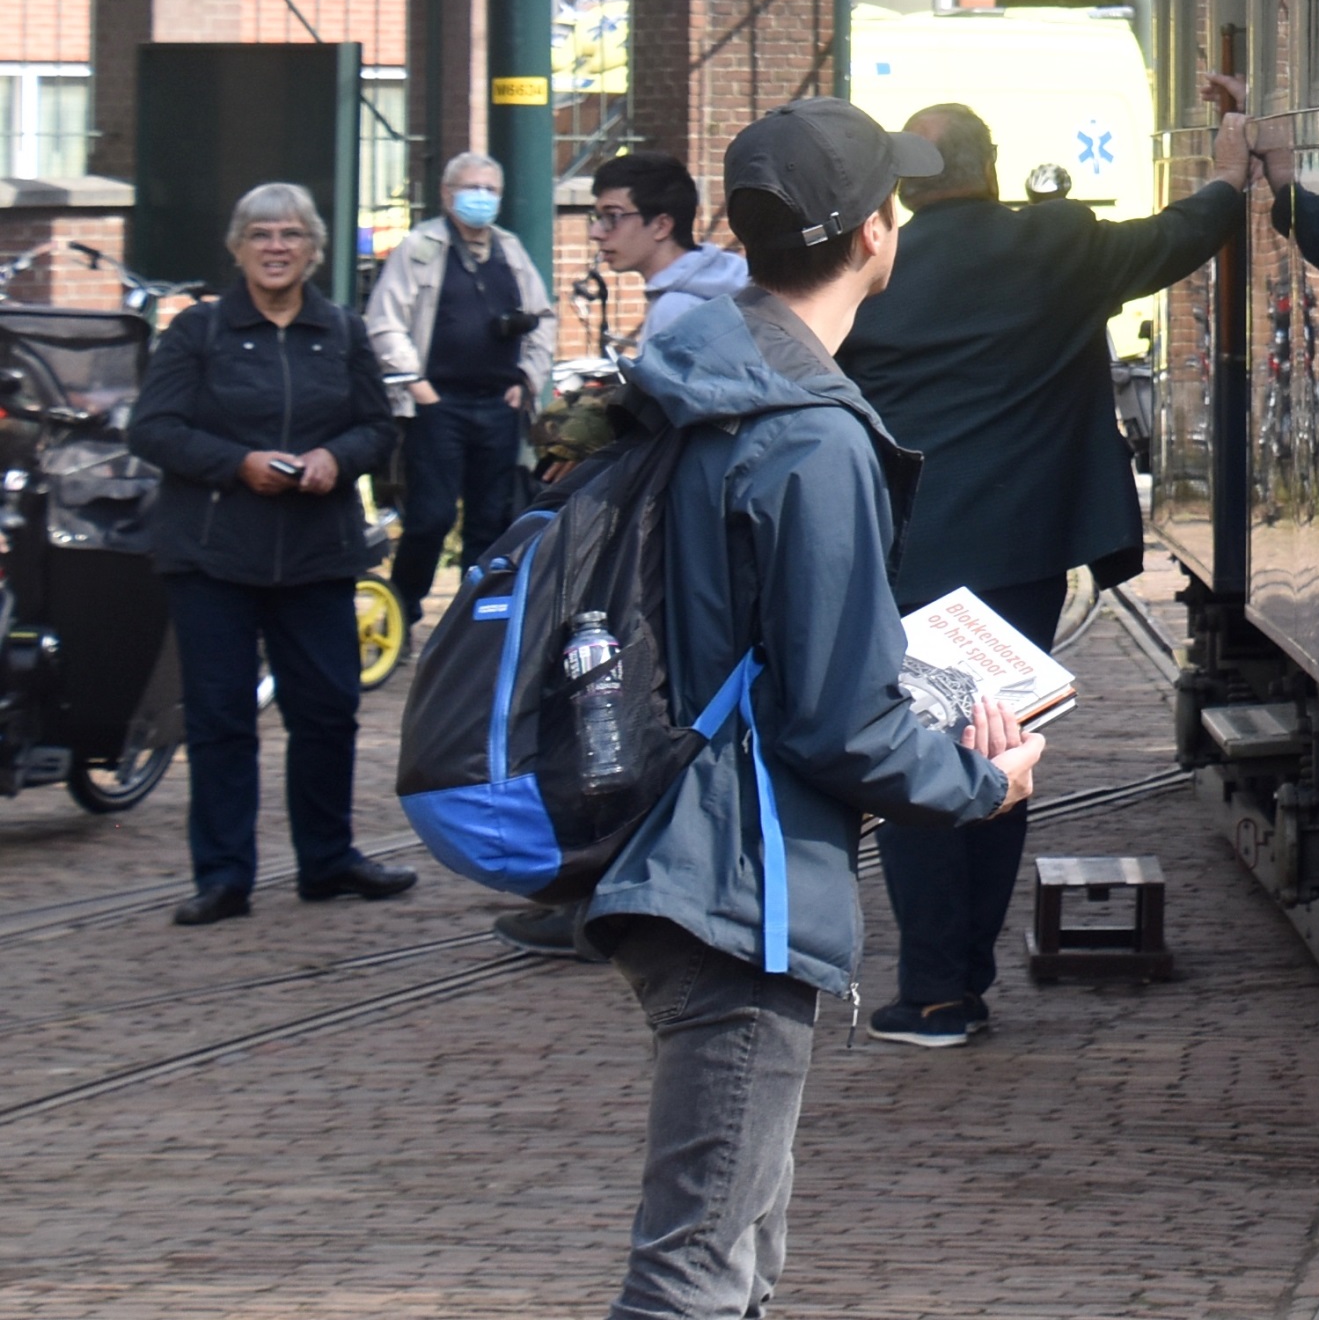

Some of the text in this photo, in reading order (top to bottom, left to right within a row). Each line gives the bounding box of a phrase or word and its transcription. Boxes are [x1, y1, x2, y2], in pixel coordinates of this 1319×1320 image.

[927, 613, 1007, 677] op het spoor
[945, 602, 1034, 676] Blokkendozen
